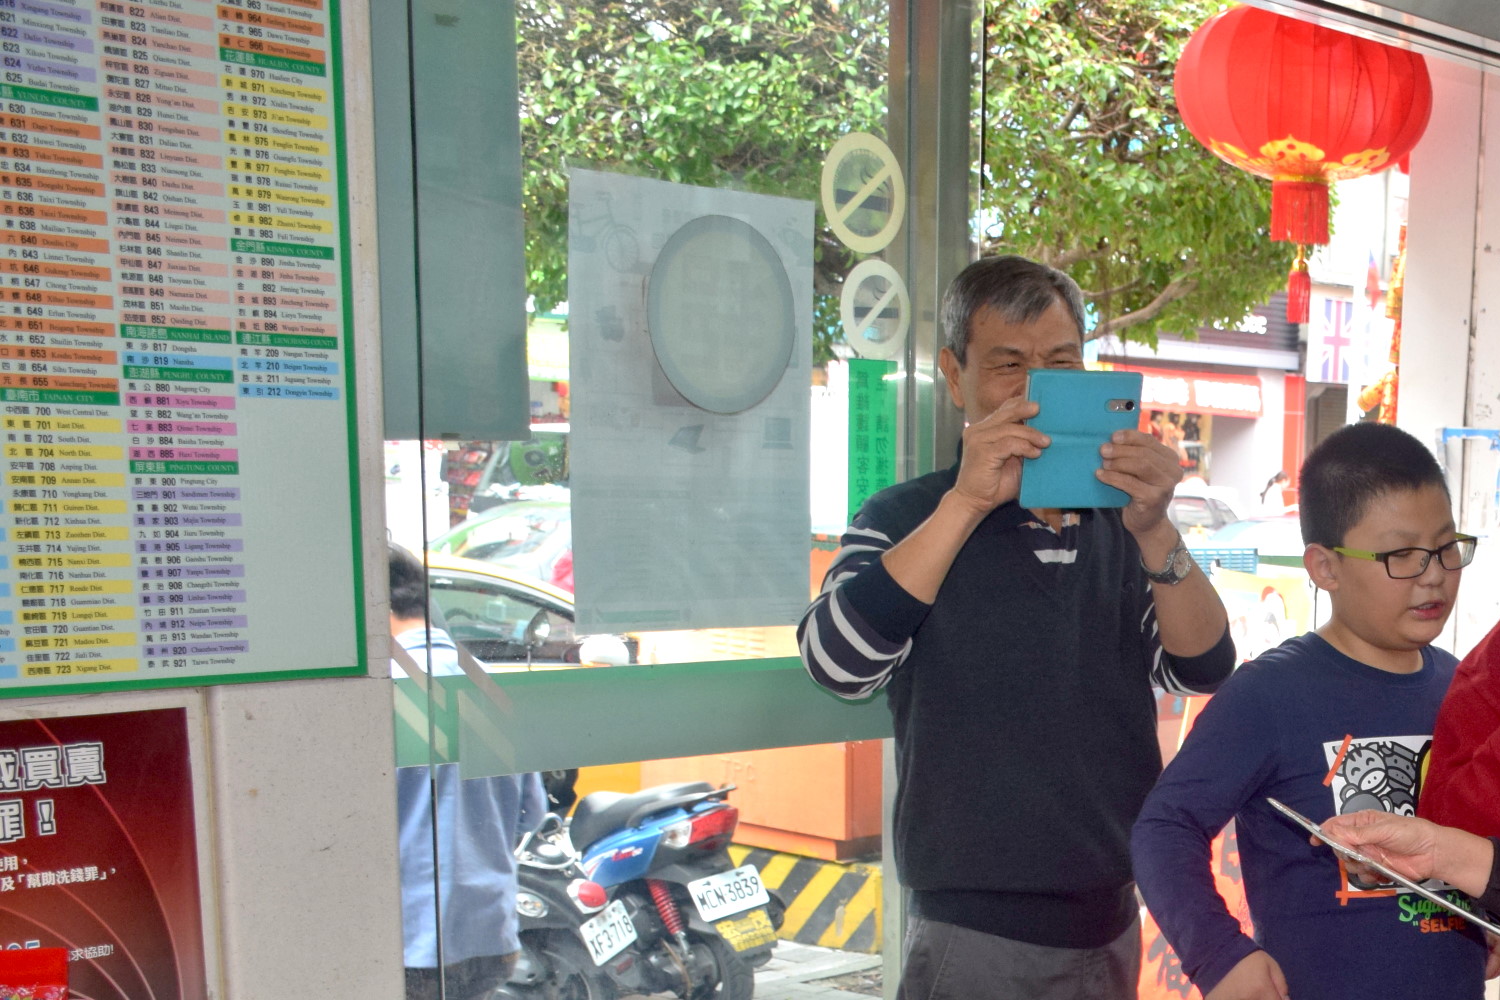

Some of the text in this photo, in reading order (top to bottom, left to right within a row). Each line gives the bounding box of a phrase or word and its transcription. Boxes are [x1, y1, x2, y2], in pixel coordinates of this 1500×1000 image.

[131, 21, 146, 31] 823
[3, 42, 20, 53] 623
[6, 72, 22, 83] 625
[251, 69, 265, 79] 970
[135, 79, 150, 89] 827
[253, 96, 267, 106] 972
[9, 103, 25, 114] 630
[254, 123, 268, 132] 974
[12, 133, 28, 144] 632
[139, 135, 153, 145] 831
[256, 150, 269, 159] 976
[15, 162, 30, 172] 634
[141, 163, 156, 173] 833
[17, 192, 33, 201] 636
[143, 191, 158, 201] 842
[258, 190, 271, 199] 979
[258, 203, 271, 212] 981
[20, 221, 36, 230] 638
[22, 249, 38, 259] 643
[261, 258, 274, 266] 890
[25, 278, 40, 287] 647
[149, 274, 163, 283] 848
[263, 284, 276, 292] 892
[151, 302, 164, 310] 851
[27, 307, 43, 316] 649
[264, 310, 277, 318] 894
[30, 335, 45, 344] 652
[153, 343, 167, 351] 817
[154, 357, 168, 365] 819
[32, 363, 47, 372] 654
[266, 362, 279, 370] 210
[155, 384, 170, 392] 880
[268, 388, 280, 396] 212
[36, 407, 51, 415] 700
[157, 410, 172, 419] 882
[36, 421, 51, 429] 701
[38, 435, 53, 443] 702
[159, 437, 173, 445] 884
[39, 449, 54, 457] 704
[40, 463, 55, 471] 708
[162, 478, 176, 486] 900
[42, 490, 57, 498] 710
[164, 504, 178, 512] 902
[165, 530, 179, 538] 904
[46, 545, 62, 553] 714
[48, 558, 63, 566] 715
[50, 585, 64, 593] 717
[53, 625, 68, 633] 720
[172, 633, 186, 641] 913
[55, 652, 70, 661] 722
[174, 659, 186, 667] 921
[57, 666, 71, 674] 723
[697, 876, 760, 912] MCN-3839
[589, 915, 634, 959] XF3-718
